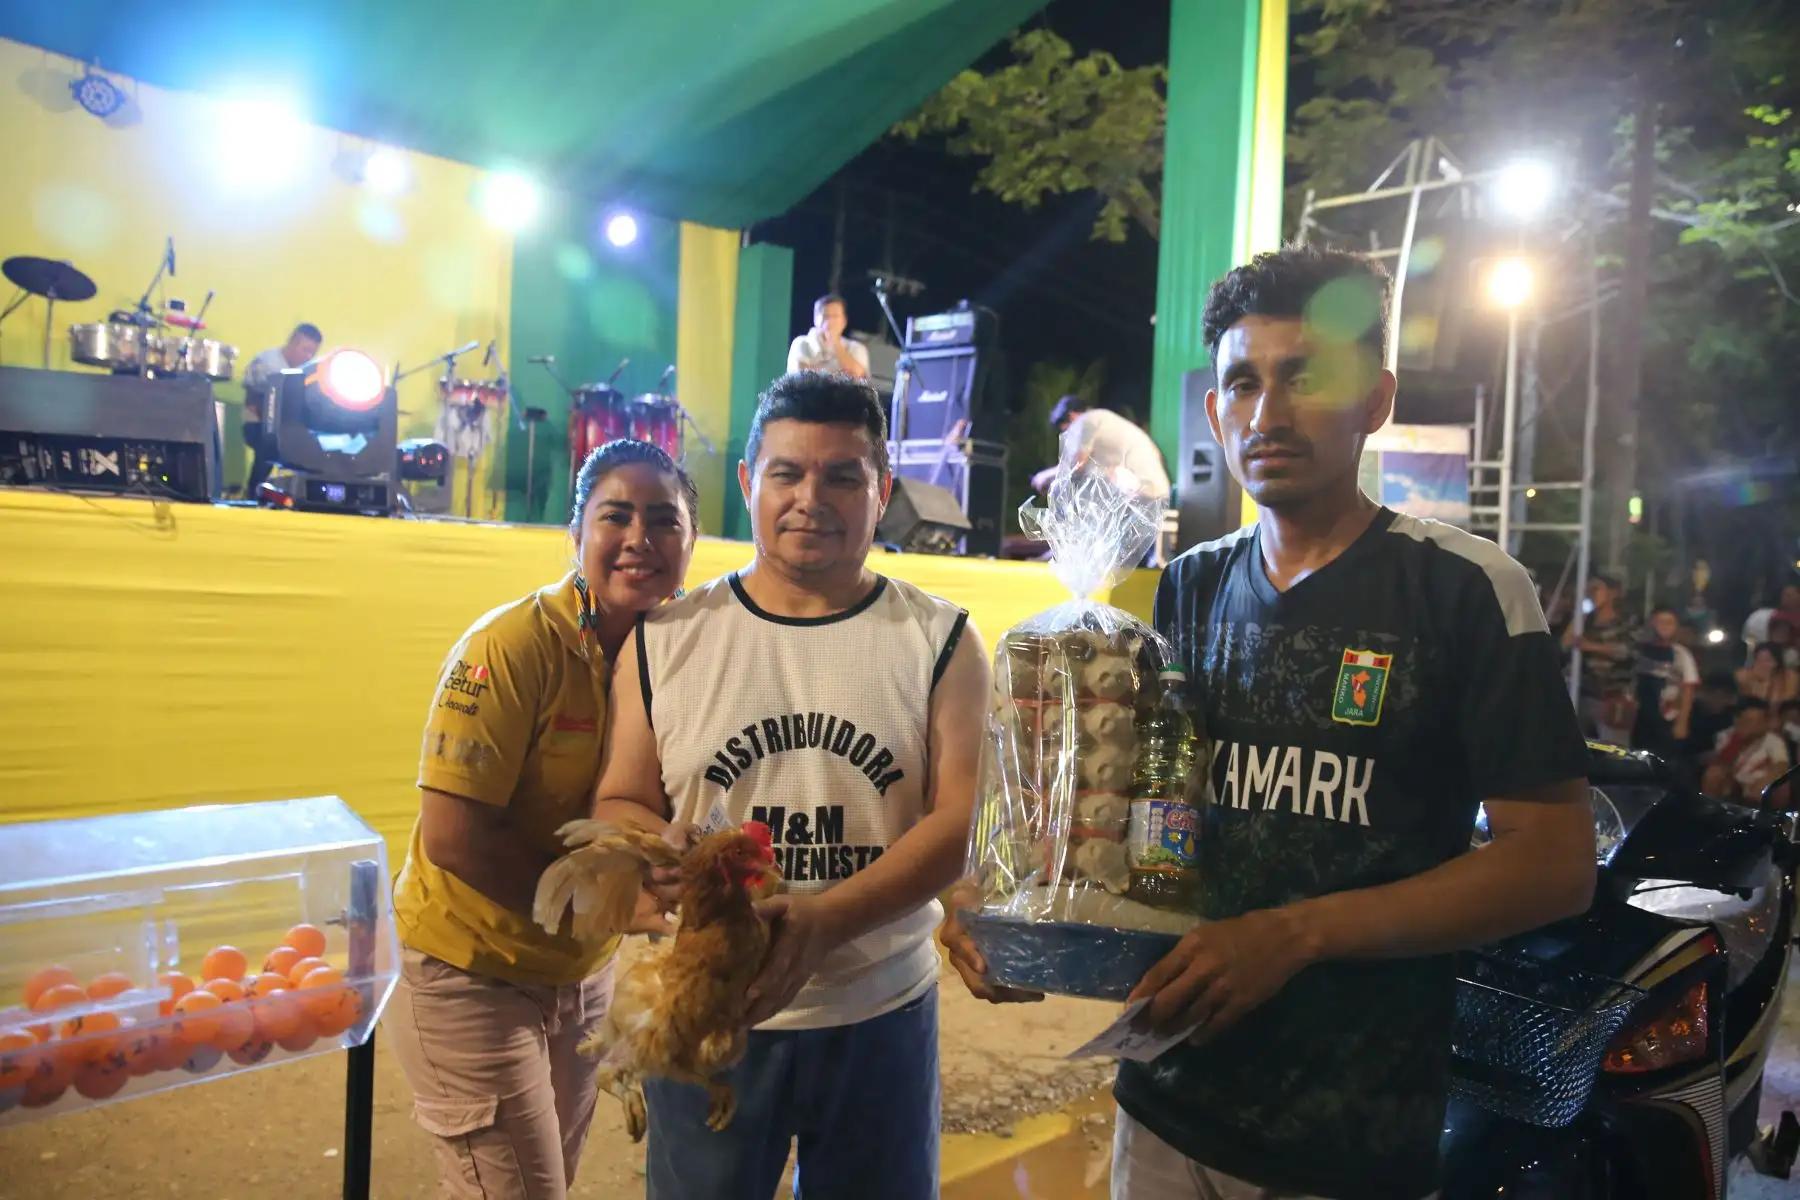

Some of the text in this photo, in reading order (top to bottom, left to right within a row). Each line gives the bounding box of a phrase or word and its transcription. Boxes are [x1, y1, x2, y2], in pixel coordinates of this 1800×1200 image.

[445, 677, 488, 698] cetur
[704, 712, 904, 797] DISTRIBUIDORA
[752, 805, 844, 845] M&M
